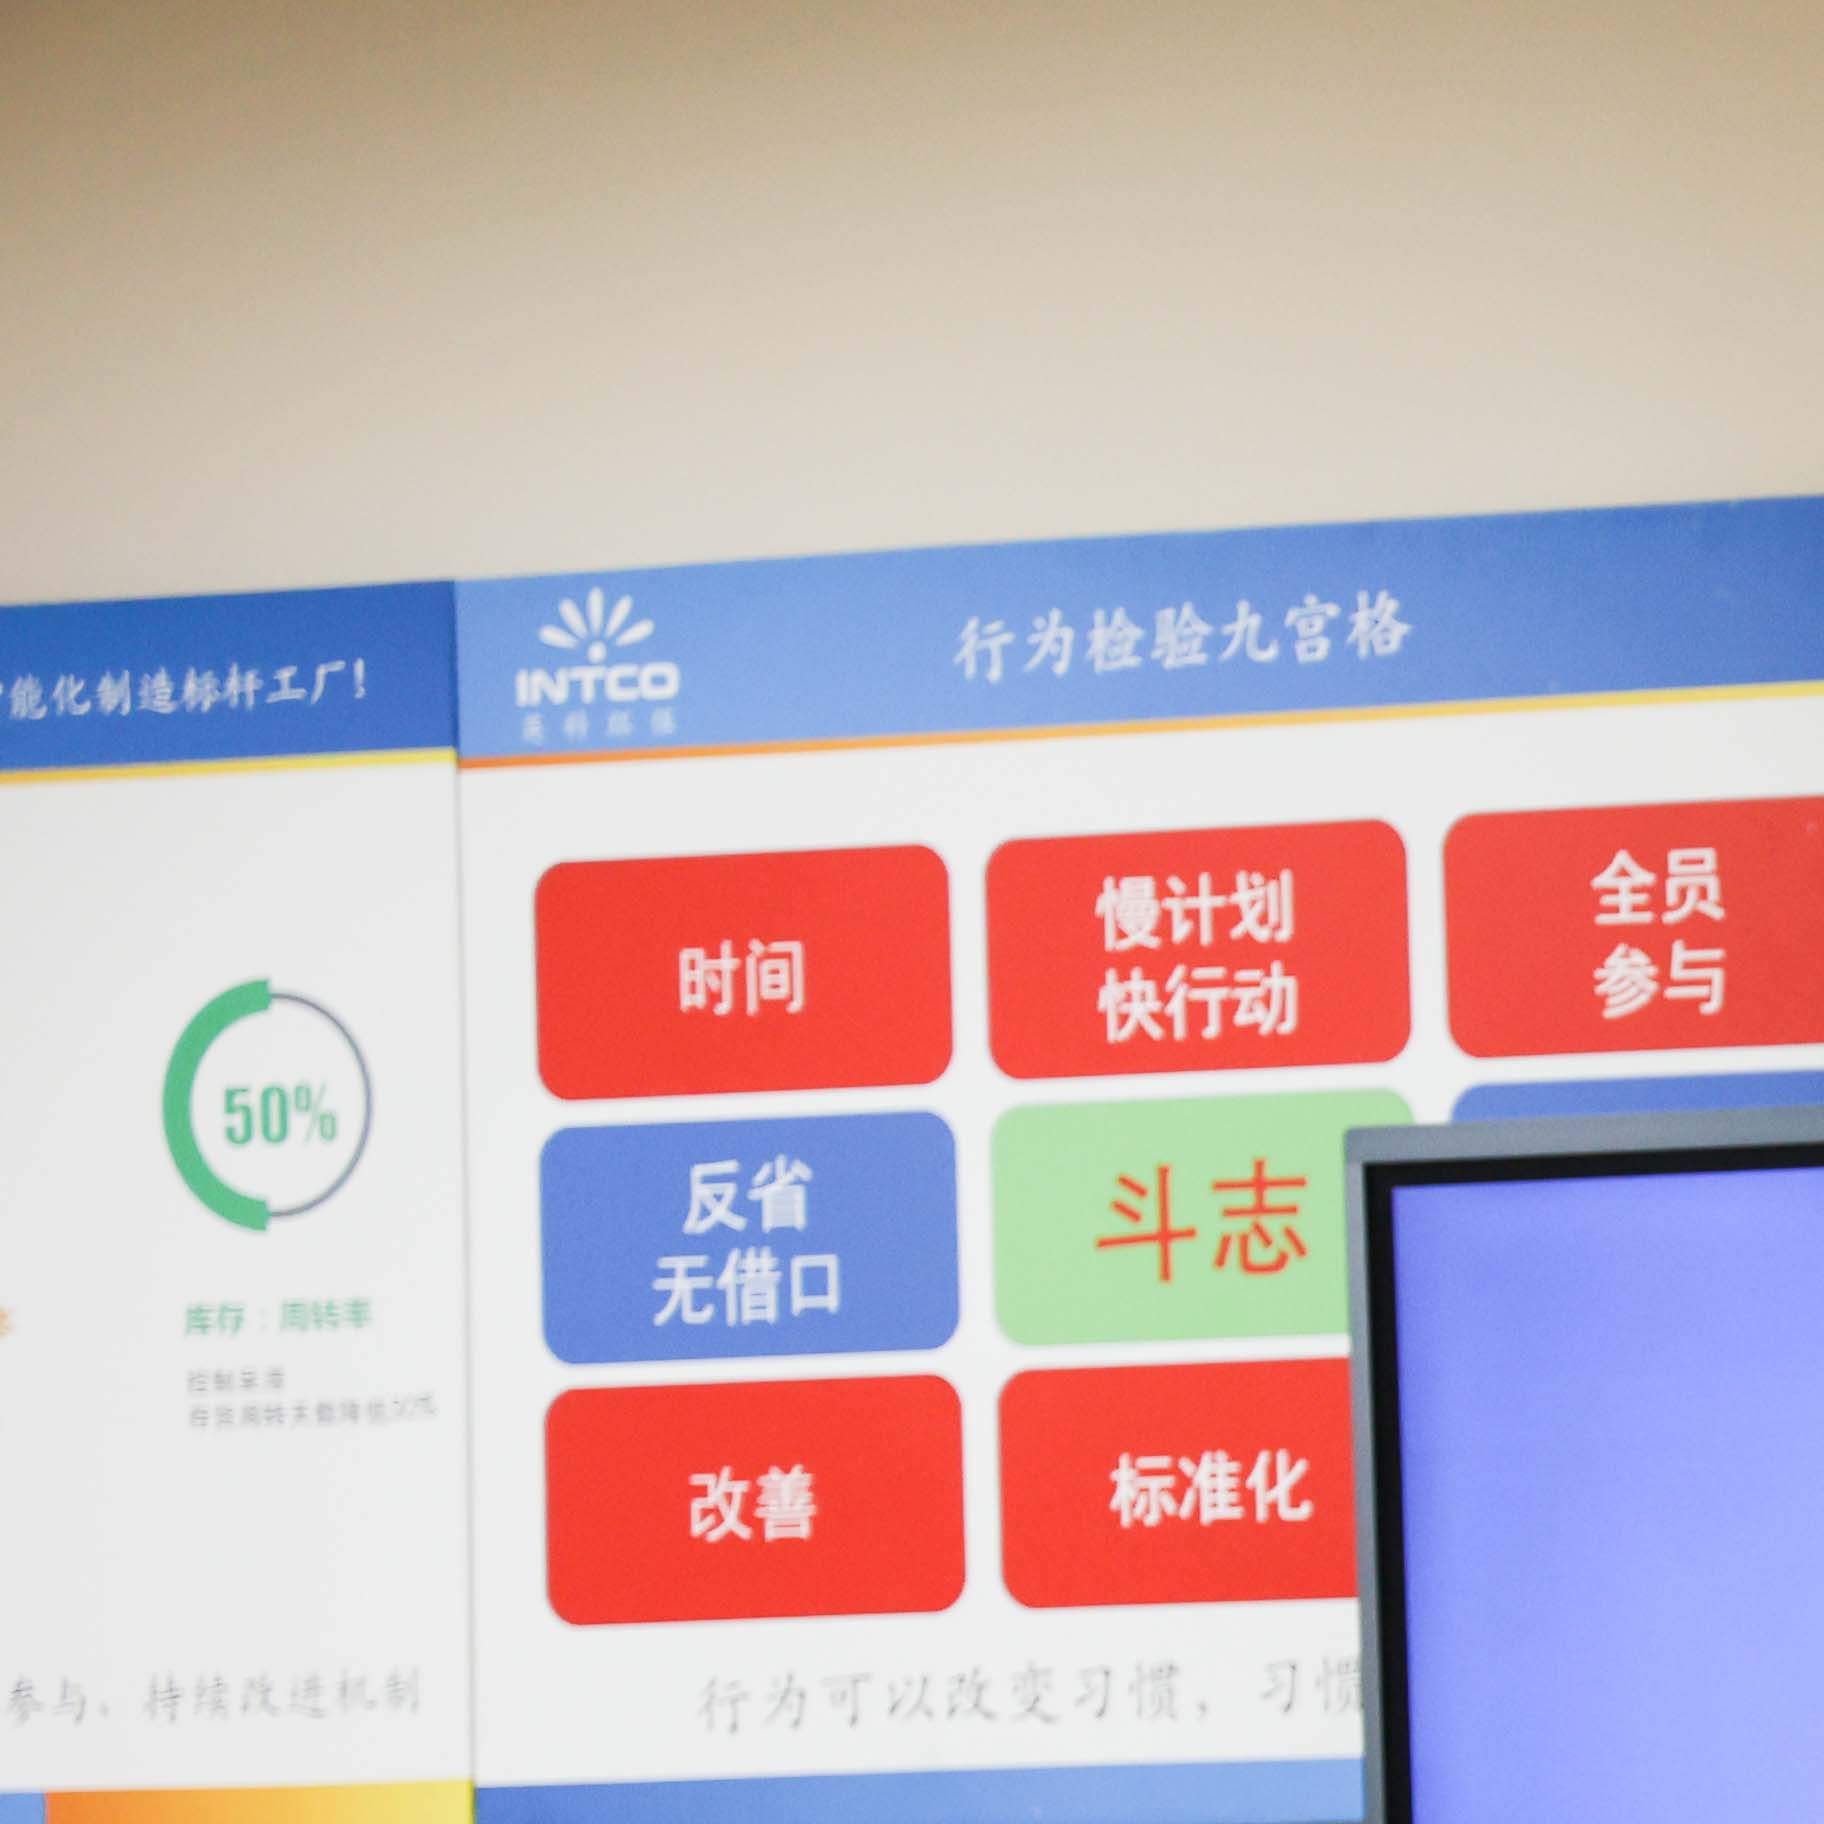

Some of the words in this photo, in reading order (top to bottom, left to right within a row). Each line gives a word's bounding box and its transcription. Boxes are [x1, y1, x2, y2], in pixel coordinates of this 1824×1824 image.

[954, 592, 1411, 684] 行为检验九宫格
[515, 662, 680, 707] INTCO
[1095, 869, 1295, 953] 慢计划
[1590, 848, 1726, 926] 全员
[679, 938, 806, 1016] 时间
[1097, 961, 1299, 1045] 快行动
[1593, 939, 1726, 1020] 参与
[223, 1084, 338, 1146] 50%
[682, 1154, 813, 1235] 反省
[1096, 1159, 1308, 1282] 斗志
[652, 1246, 841, 1327] 无借口
[690, 1464, 817, 1543] 改善
[1109, 1449, 1314, 1529] 标准化
